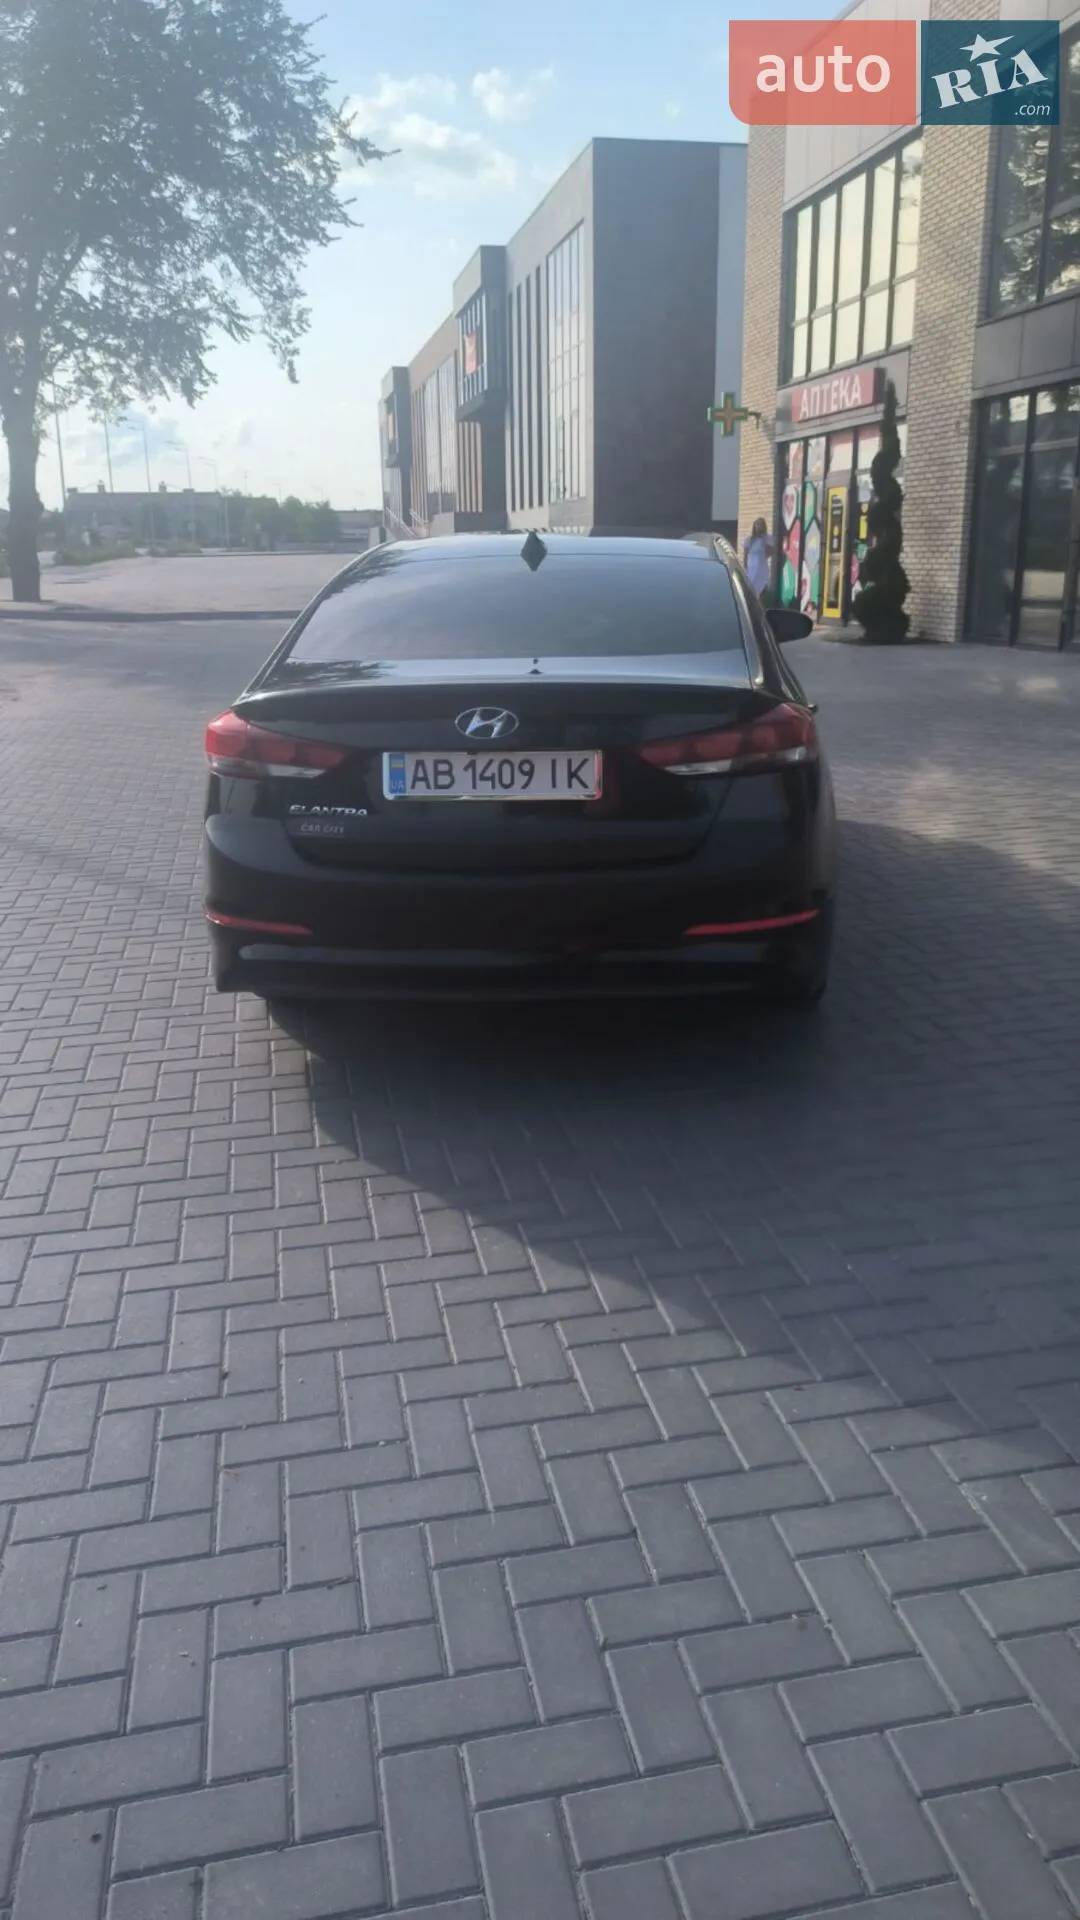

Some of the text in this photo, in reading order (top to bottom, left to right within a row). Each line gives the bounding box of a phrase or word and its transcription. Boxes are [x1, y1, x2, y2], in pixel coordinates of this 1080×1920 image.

[799, 373, 861, 421] АПТЕКА
[410, 757, 590, 790] AB 1409 IK
[289, 804, 368, 817] ELANTRA
